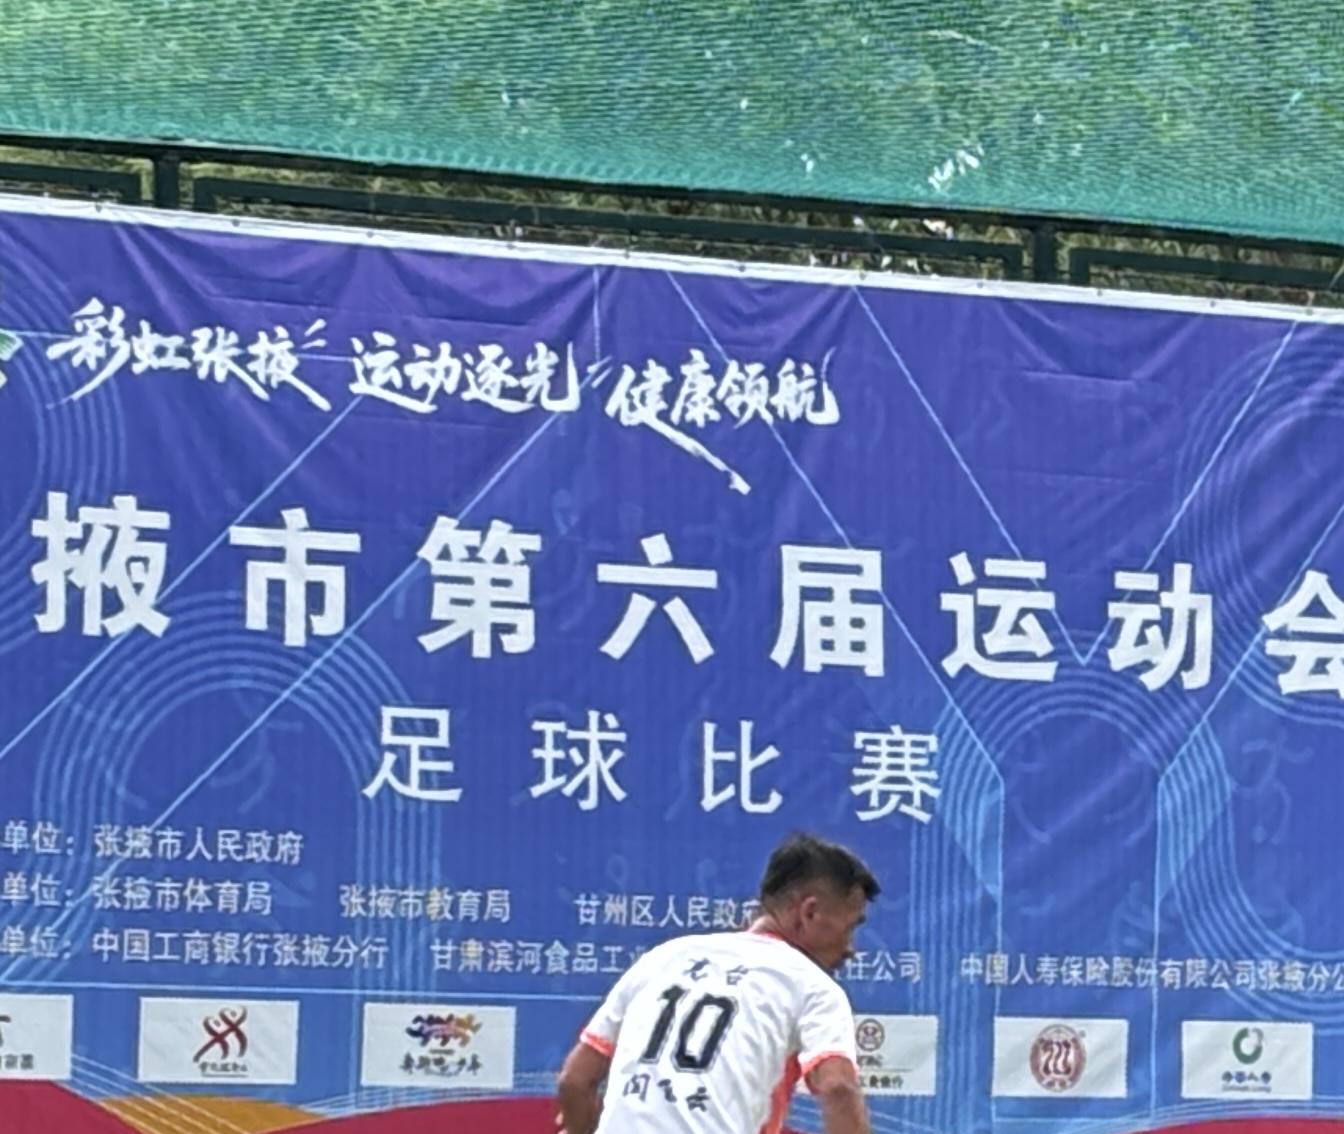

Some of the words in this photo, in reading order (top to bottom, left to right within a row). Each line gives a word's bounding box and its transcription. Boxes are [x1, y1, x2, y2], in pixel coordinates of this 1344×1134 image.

[46, 297, 332, 411] 彩虹张掖
[604, 346, 841, 495] 健康领航
[362, 705, 942, 824] 足球比赛
[338, 884, 511, 923] 张掖市教育局
[833, 950, 922, 985] 任公司
[636, 983, 739, 1074] 10
